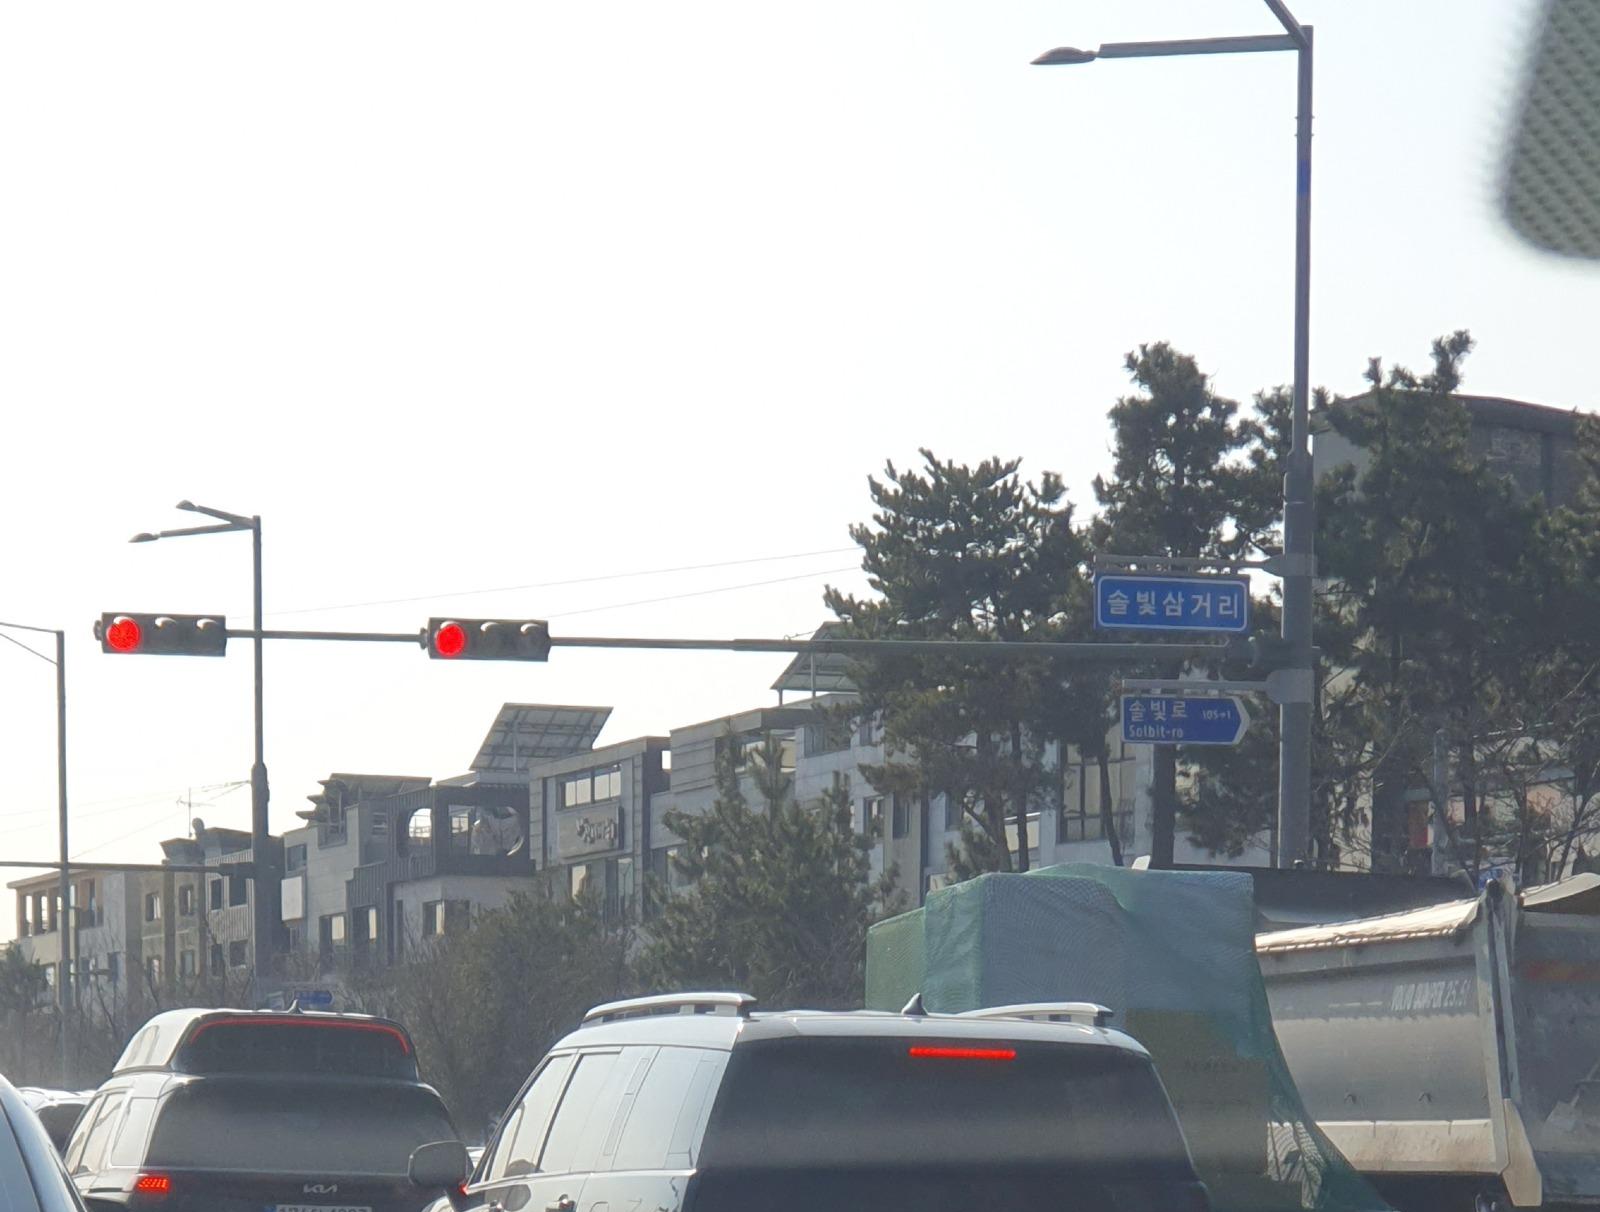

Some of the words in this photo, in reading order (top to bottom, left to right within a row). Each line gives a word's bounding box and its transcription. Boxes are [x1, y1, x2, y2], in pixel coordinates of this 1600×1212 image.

[1107, 589, 1239, 619] 솔빛삼거리
[1128, 699, 1189, 722] 솔빛로
[1129, 724, 1184, 739] Solbit-ro
